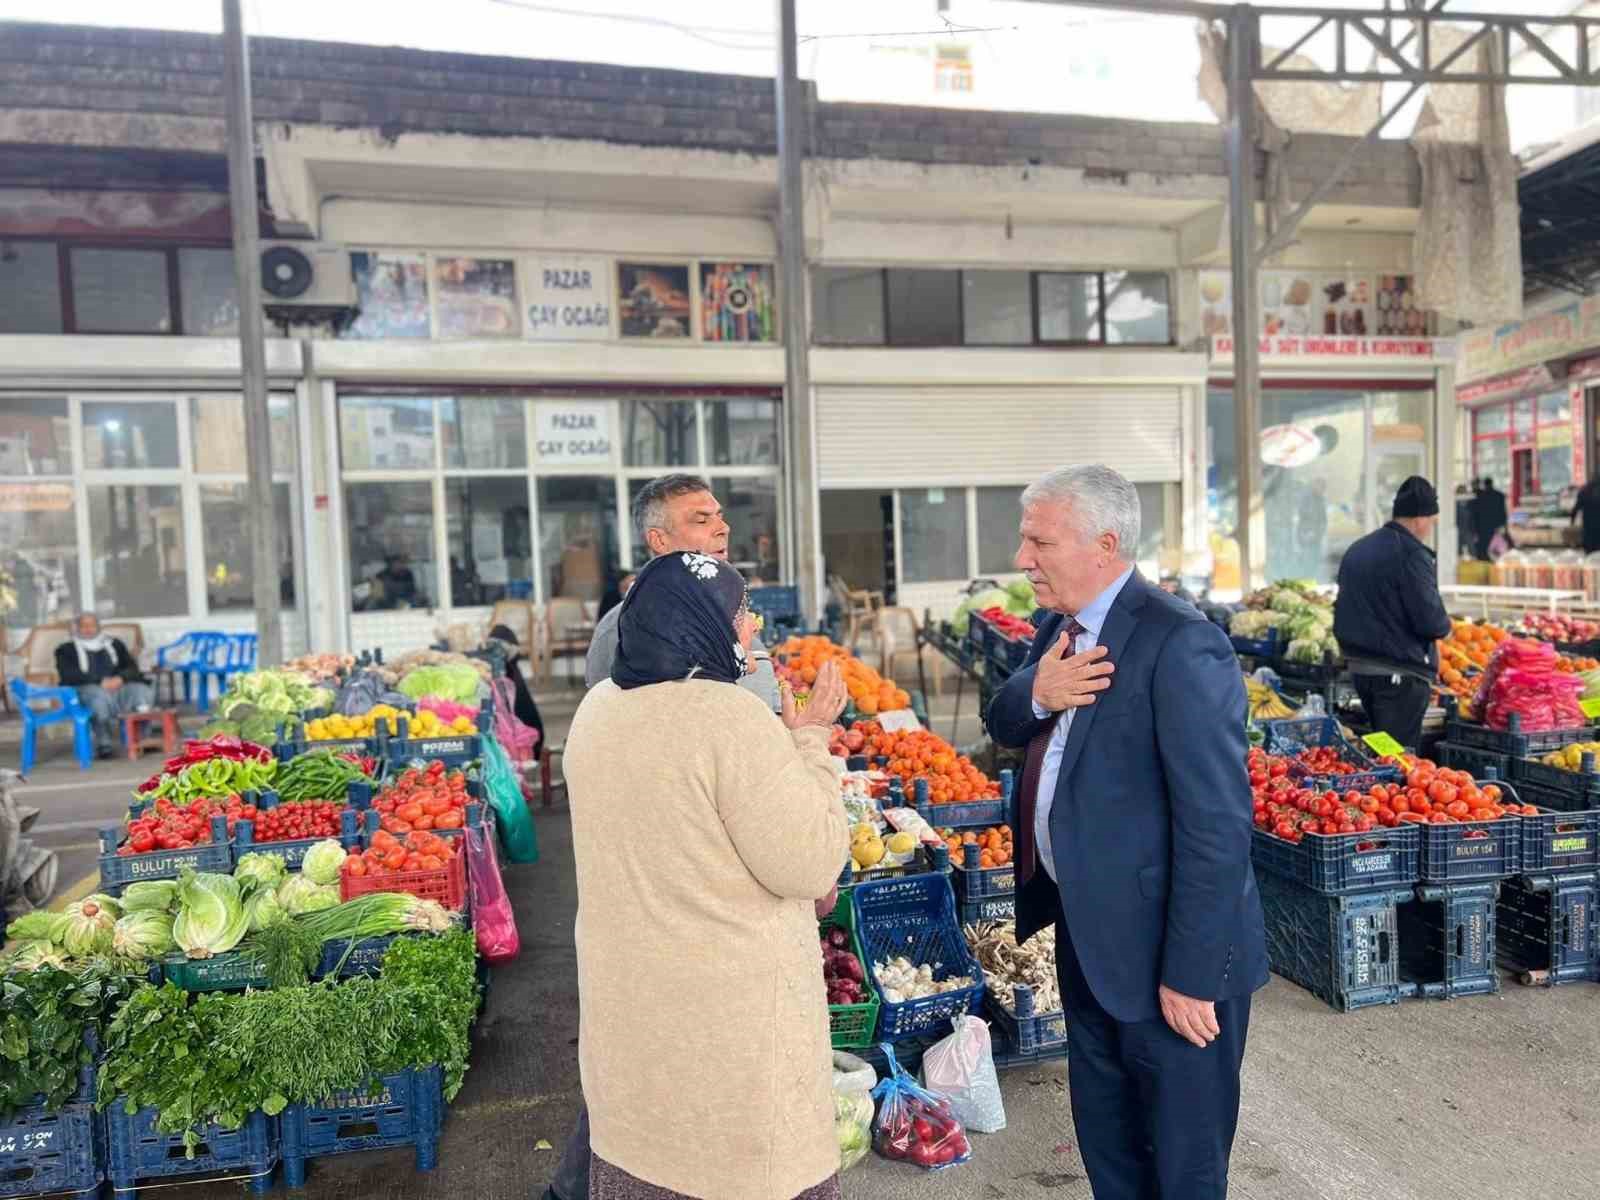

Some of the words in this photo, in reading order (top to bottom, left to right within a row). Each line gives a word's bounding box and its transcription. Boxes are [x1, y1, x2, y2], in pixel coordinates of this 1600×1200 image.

[543, 269, 592, 288] PAZAR
[528, 304, 557, 328] ÇAY
[562, 302, 609, 326] OCAĞI
[551, 414, 596, 428] PAZAR
[536, 439, 563, 455] ÇAY
[567, 437, 610, 455] OCAĞI
[131, 858, 172, 875] BULUT
